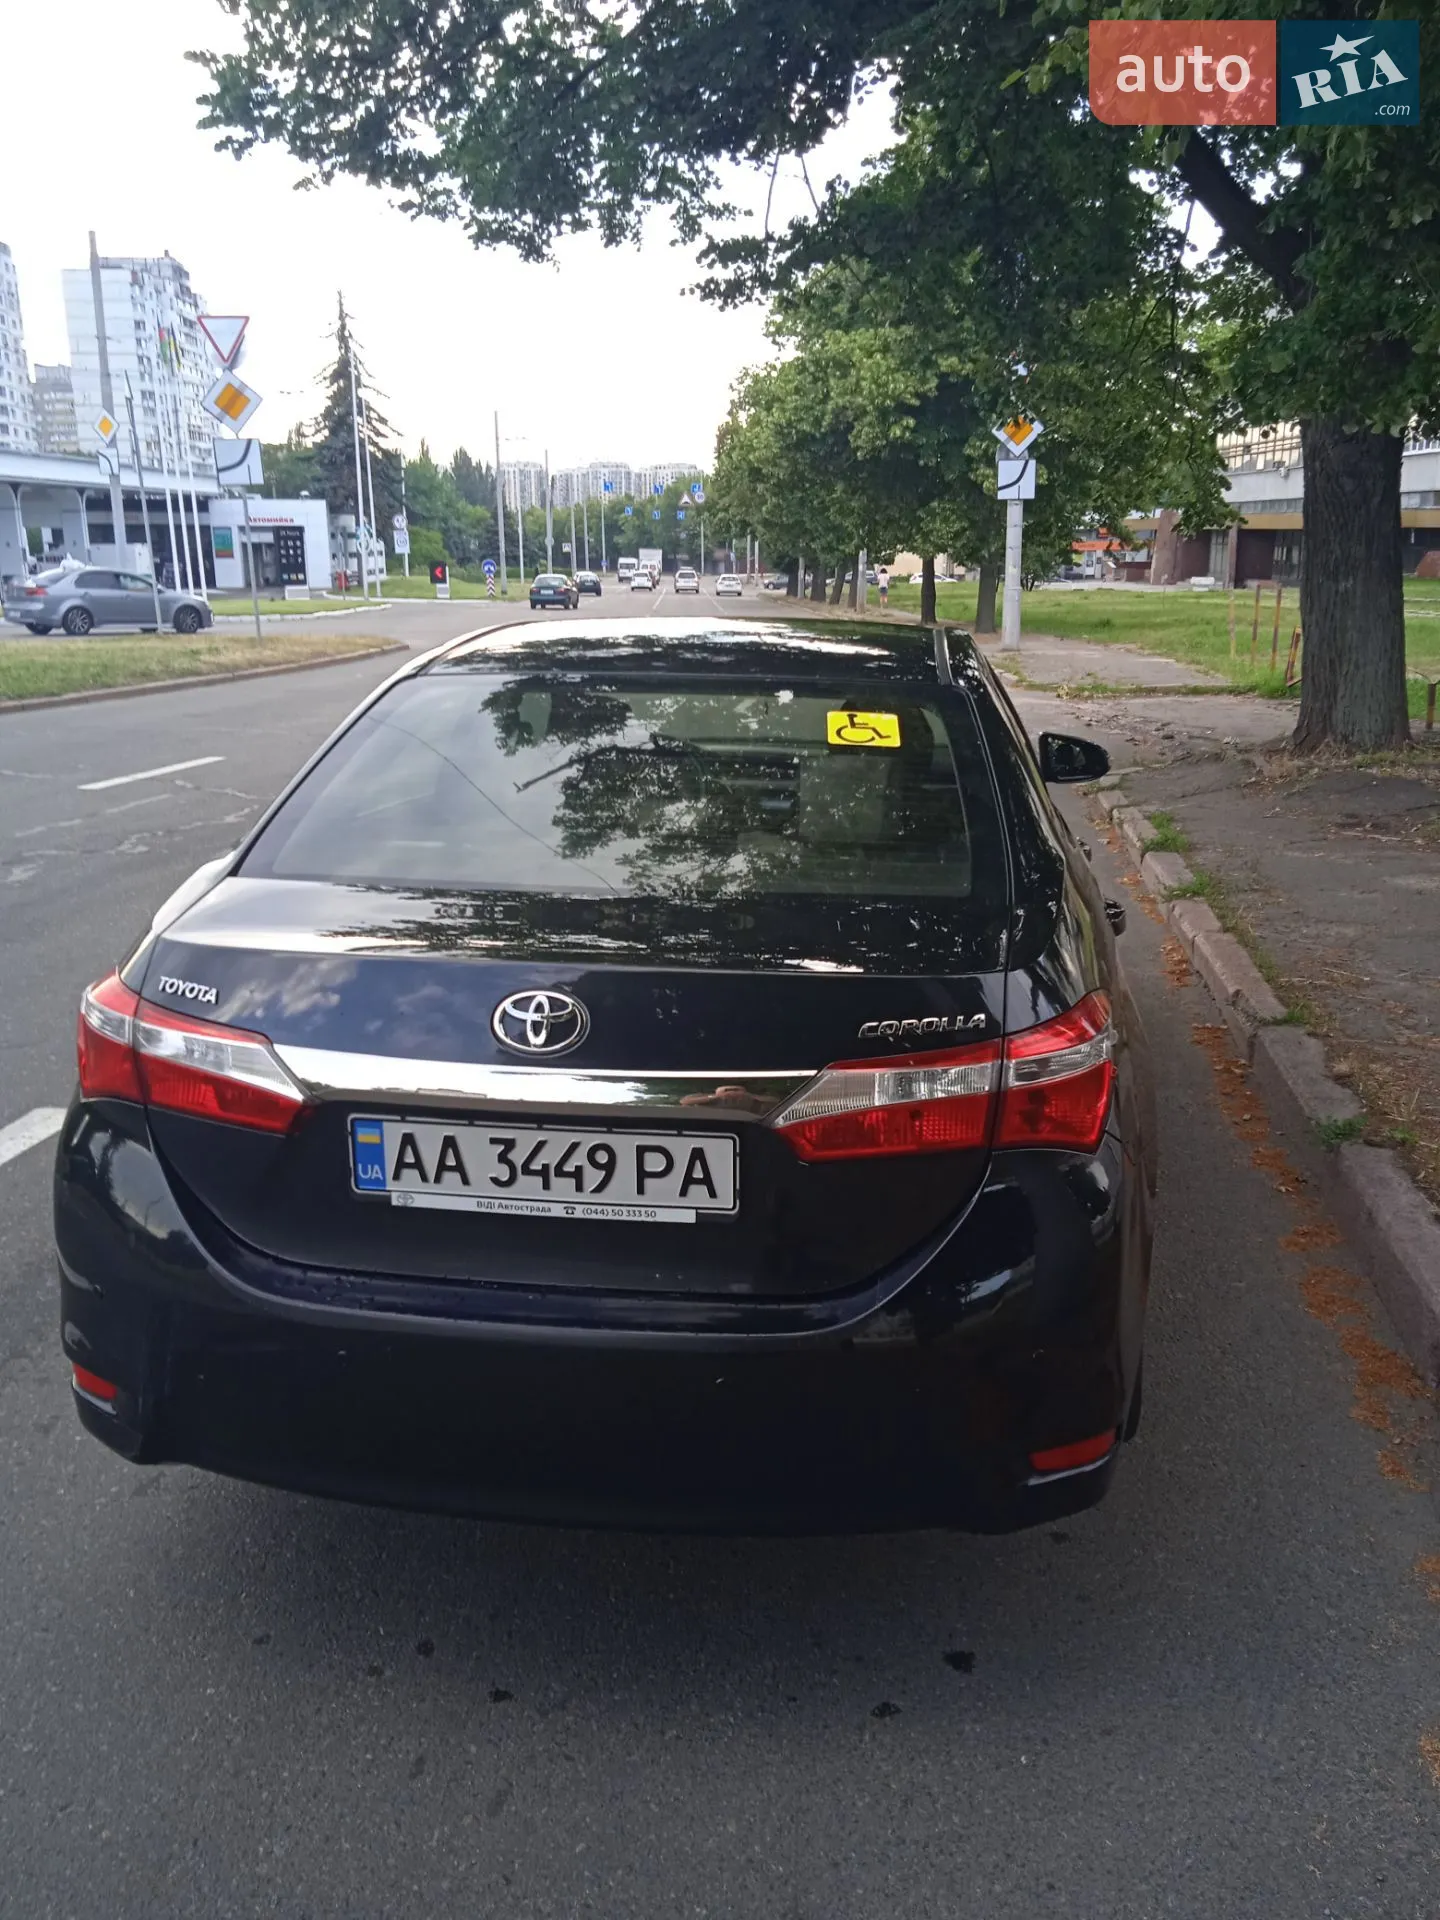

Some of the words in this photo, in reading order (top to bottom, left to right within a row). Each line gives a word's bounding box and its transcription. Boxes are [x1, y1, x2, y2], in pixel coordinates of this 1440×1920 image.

[158, 976, 218, 1004] TOYOTA
[858, 1013, 986, 1038] COROLLA
[357, 1164, 384, 1181] UA
[392, 1131, 471, 1187] AA
[488, 1136, 617, 1195] 3449
[636, 1144, 718, 1199] PA
[497, 1202, 552, 1214] Автострада
[582, 1207, 609, 1217] (044)
